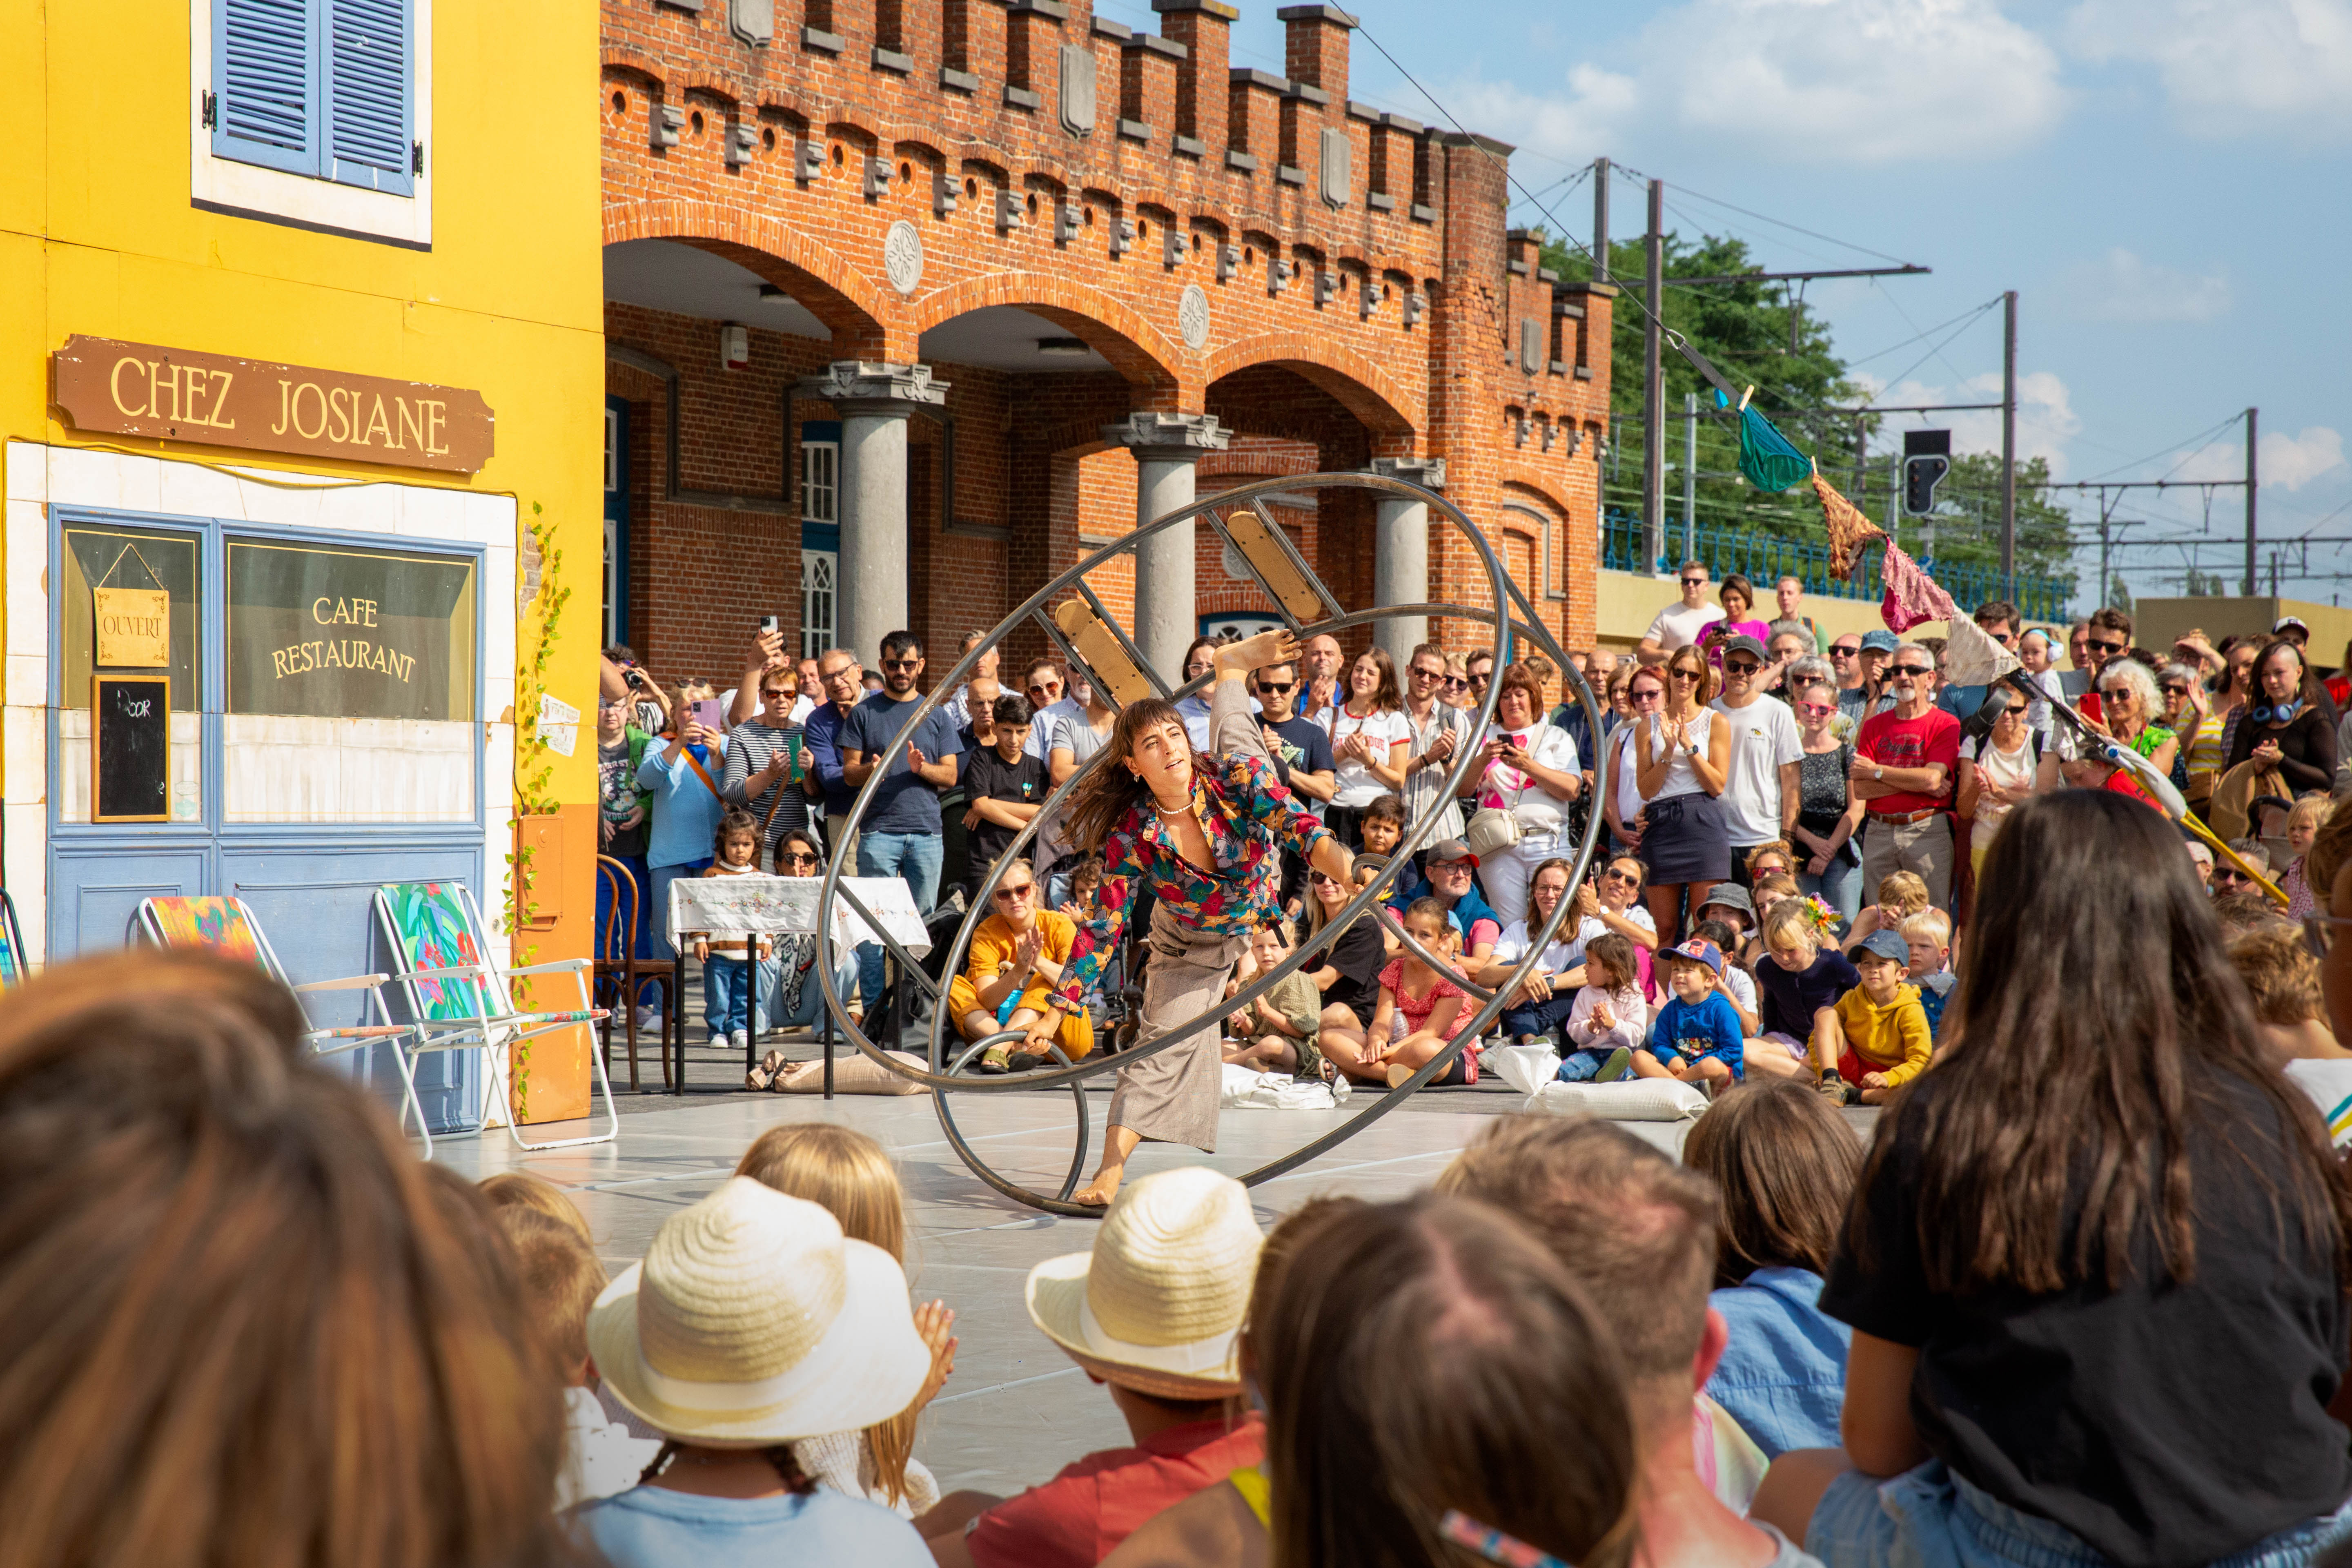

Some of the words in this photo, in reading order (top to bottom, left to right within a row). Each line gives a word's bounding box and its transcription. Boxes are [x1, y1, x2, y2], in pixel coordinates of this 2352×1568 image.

[110, 356, 236, 430] CHEZ
[271, 379, 450, 455] JOSIANE
[103, 615, 161, 638] OUVERT
[313, 597, 377, 628] CAFE
[272, 640, 416, 683] RESTAURANT
